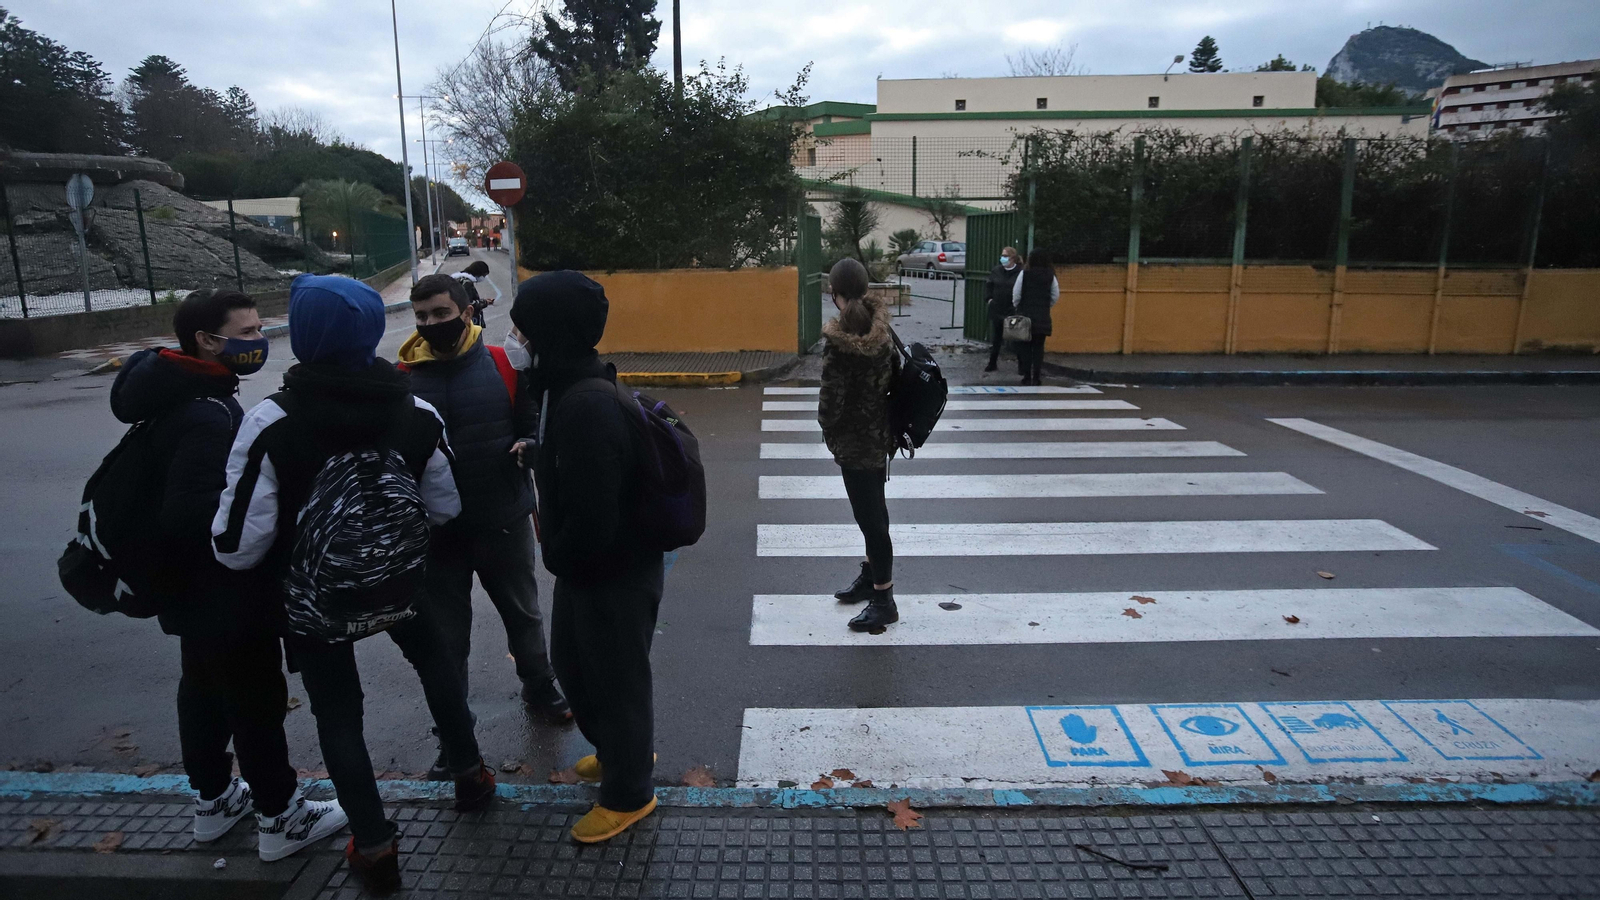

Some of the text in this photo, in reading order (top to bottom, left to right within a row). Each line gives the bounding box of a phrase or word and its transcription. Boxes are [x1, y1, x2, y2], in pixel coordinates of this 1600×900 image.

[346, 619, 378, 635] NEW
[1208, 745, 1247, 755] MIRA
[1453, 741, 1502, 750] CRUZA
[1070, 746, 1110, 756] PARA
